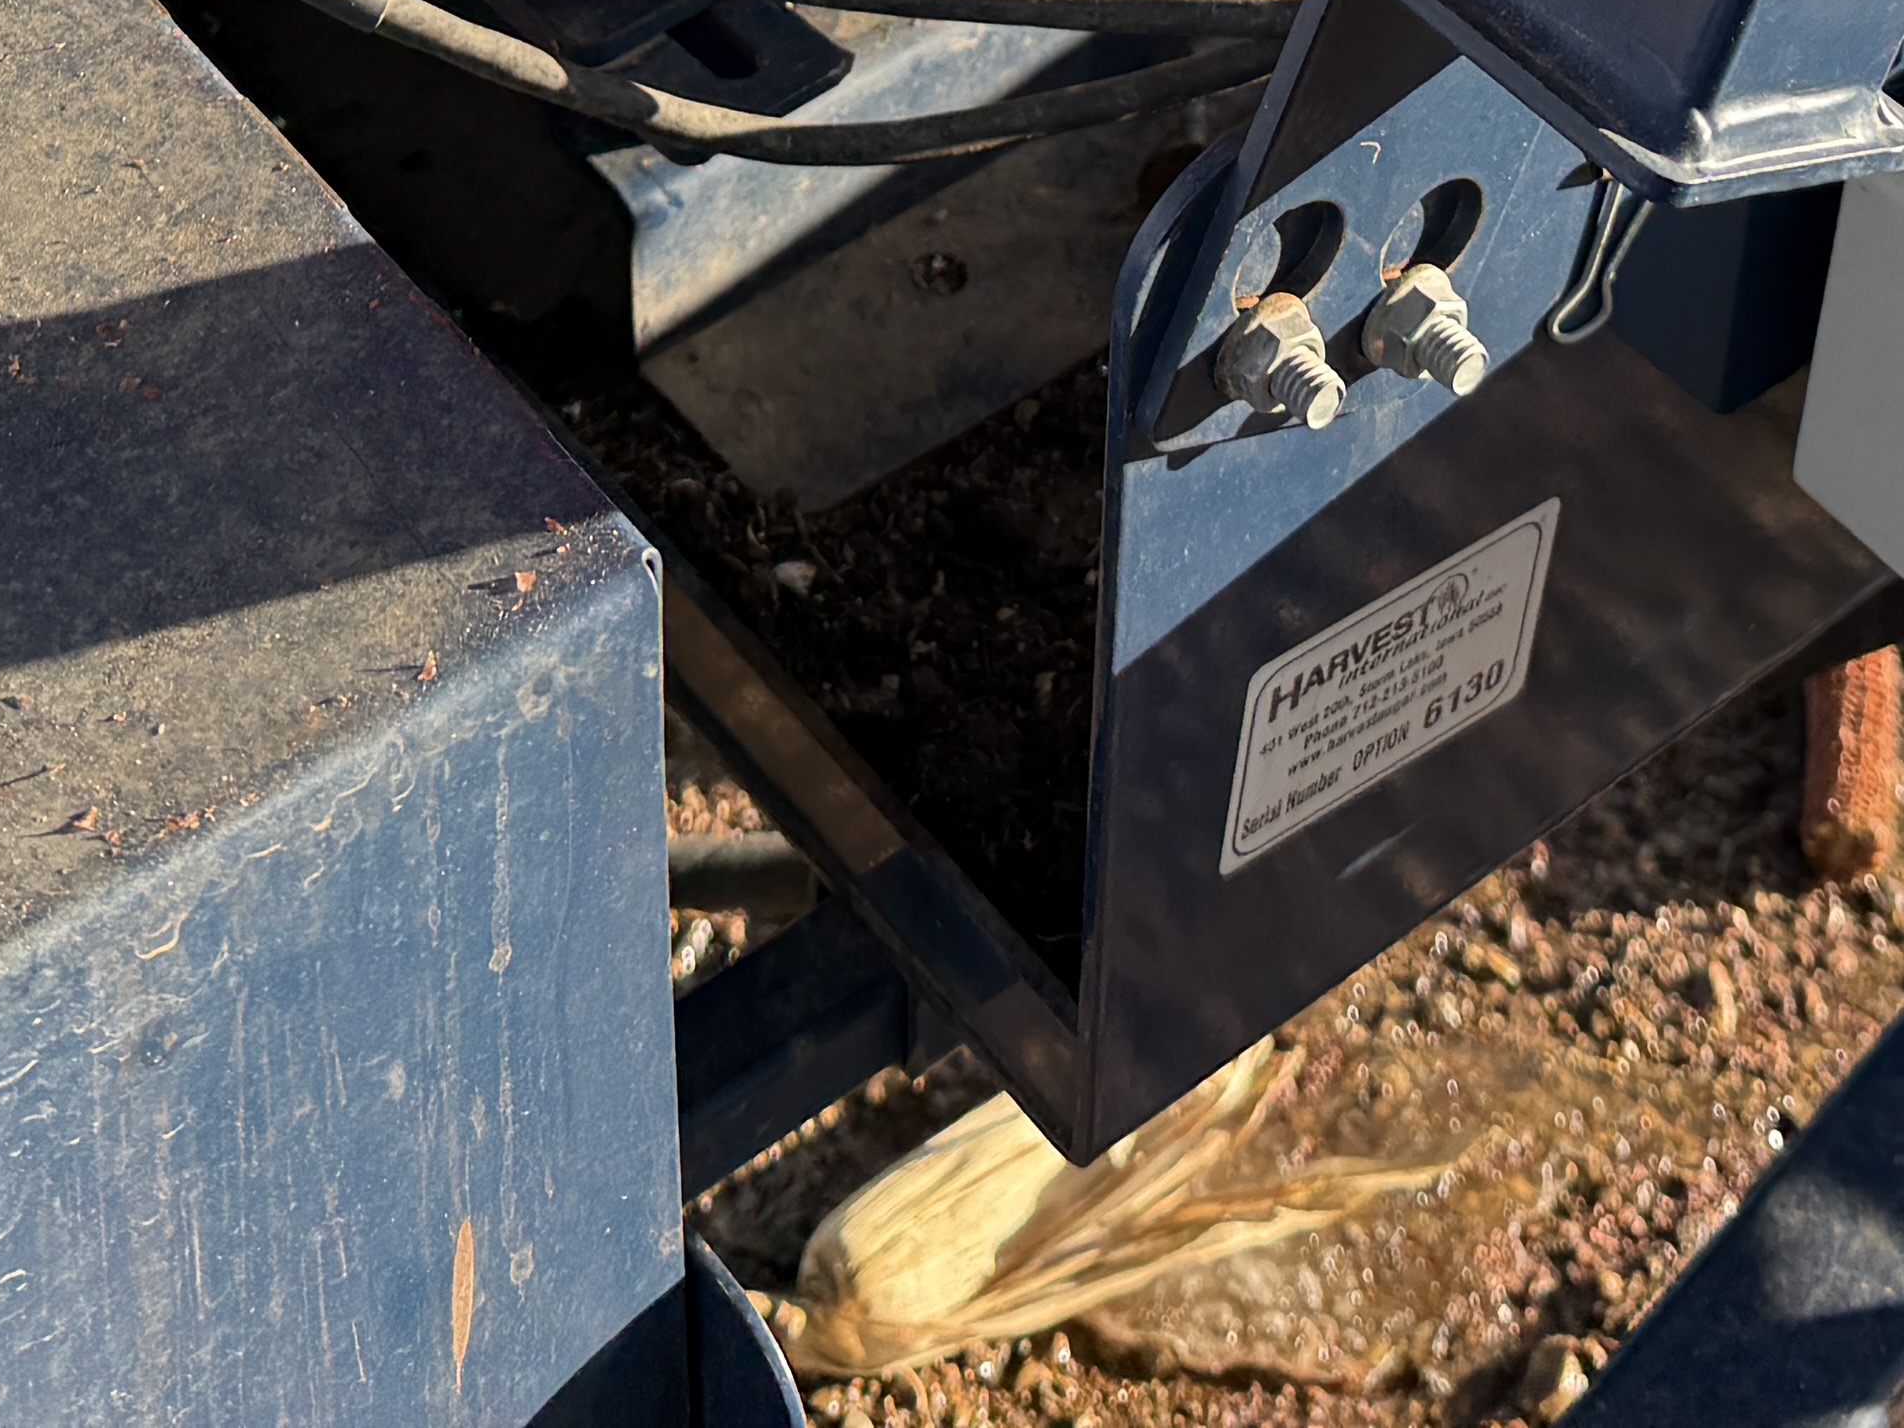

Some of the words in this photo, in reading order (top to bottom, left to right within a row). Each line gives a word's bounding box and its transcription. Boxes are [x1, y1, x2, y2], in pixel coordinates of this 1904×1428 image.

[1267, 600, 1431, 724] HARVEST
[1241, 800, 1282, 841] Serial
[1286, 766, 1343, 814] Number
[1352, 720, 1411, 771] OPTION
[1422, 658, 1505, 729] 6130
[1303, 714, 1348, 750] Phone
